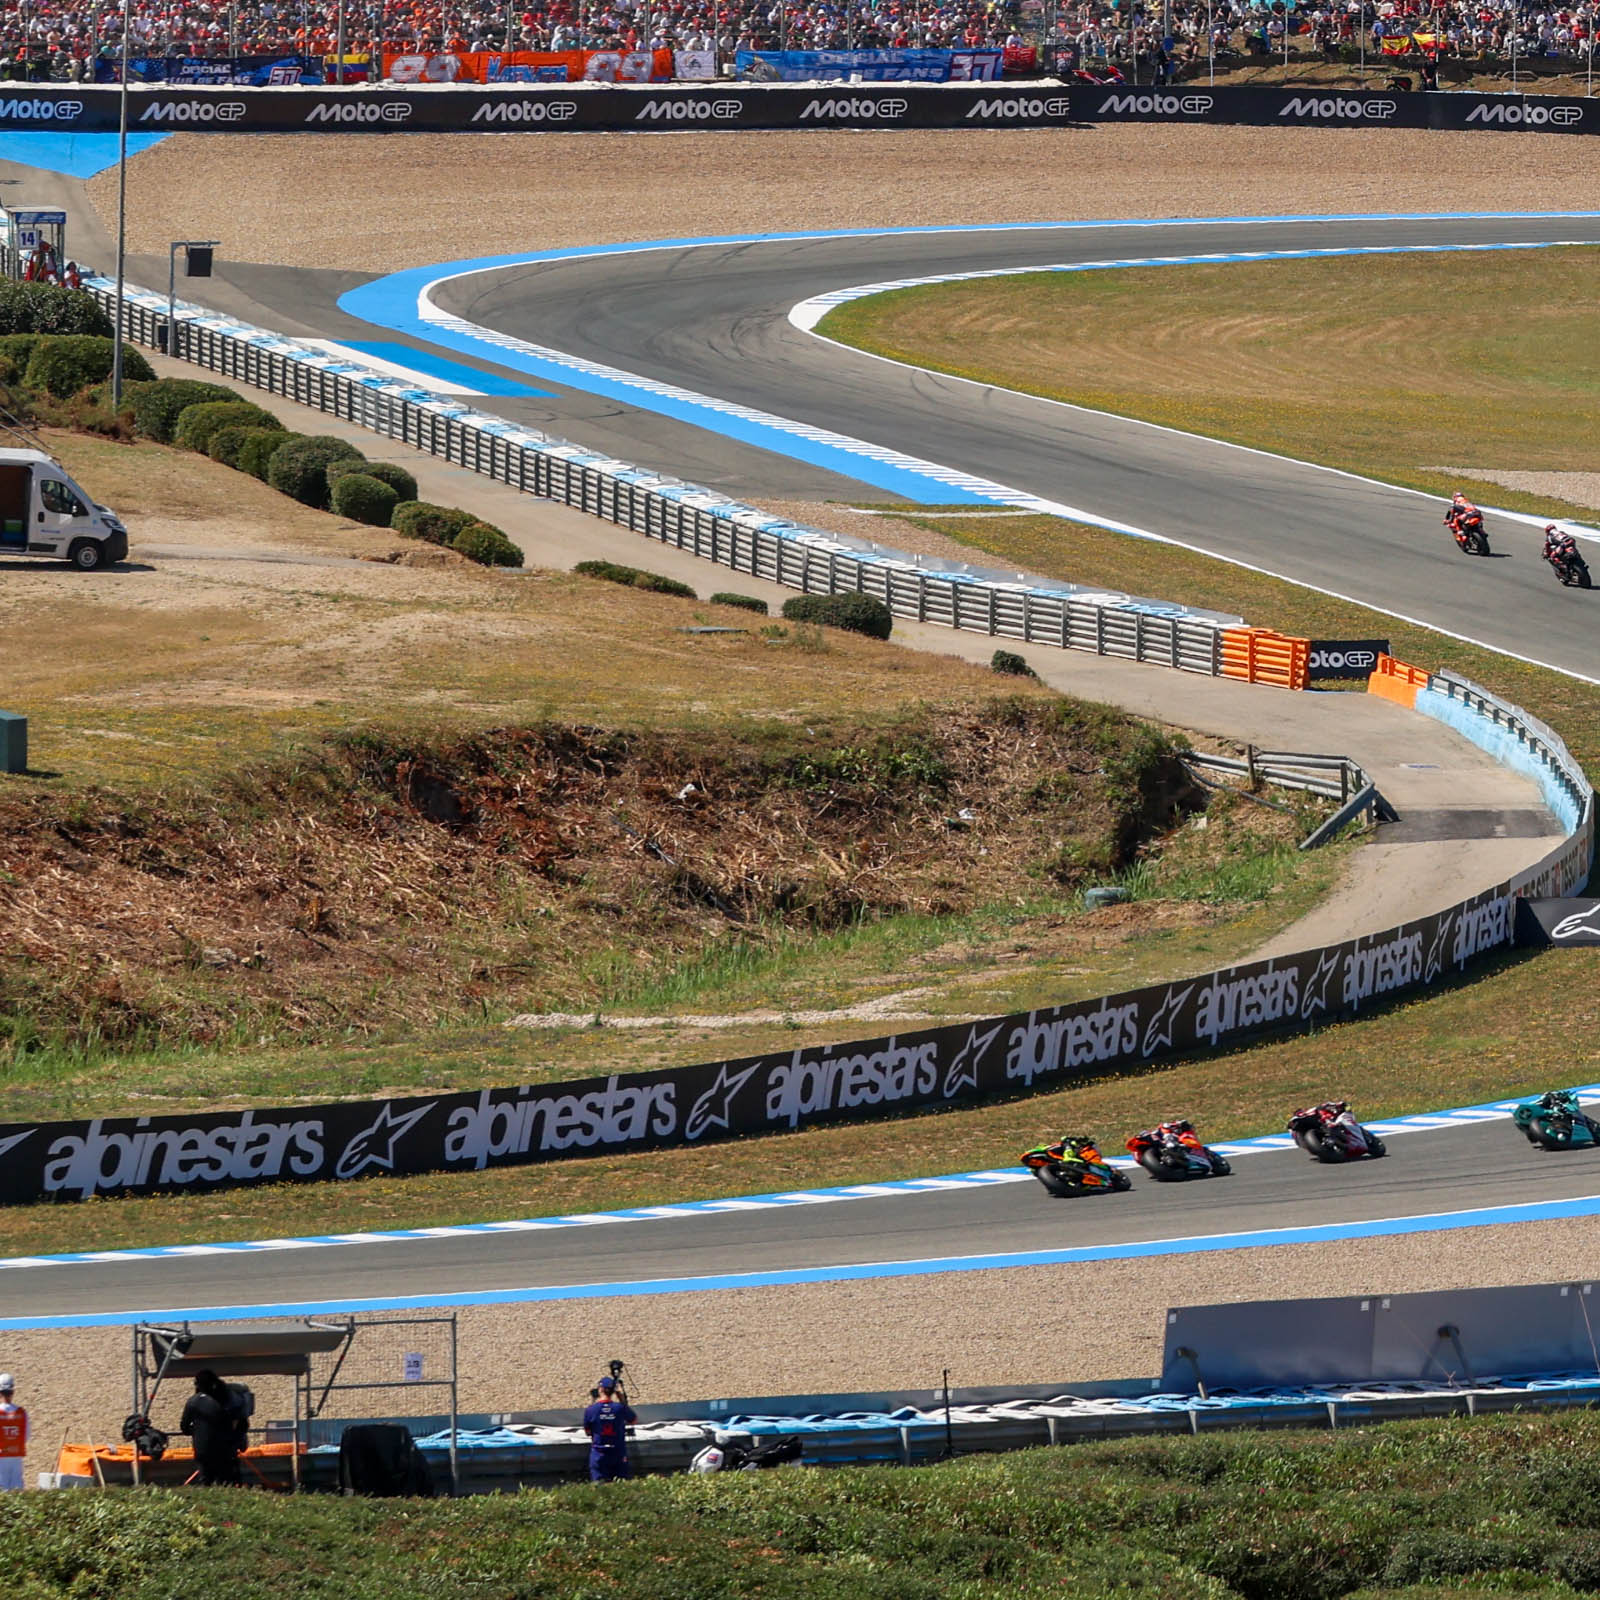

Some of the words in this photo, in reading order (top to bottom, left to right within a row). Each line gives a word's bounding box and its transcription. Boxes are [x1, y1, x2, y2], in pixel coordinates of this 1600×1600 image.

[270, 68, 302, 86] 37
[950, 53, 998, 81] 37
[140, 101, 246, 120] MotoGP
[305, 102, 412, 121] MotoGP
[472, 101, 577, 121] MotoGP
[636, 100, 742, 119] MotoGP
[800, 98, 907, 118] MotoGP
[966, 98, 1069, 117] MotoGP
[1098, 94, 1213, 114] MotoGP
[1279, 98, 1396, 118] MotoGP
[1466, 104, 1583, 125] MotoGP
[20, 233, 35, 246] 14
[1309, 650, 1376, 668] otoGP
[1343, 926, 1422, 1010] alpinestars
[1196, 960, 1298, 1046] alpinestars
[1007, 994, 1138, 1086] alpinestars
[766, 1037, 938, 1127] alpinestars
[444, 1075, 676, 1169] alpinestars
[43, 1111, 323, 1197] alpinestars
